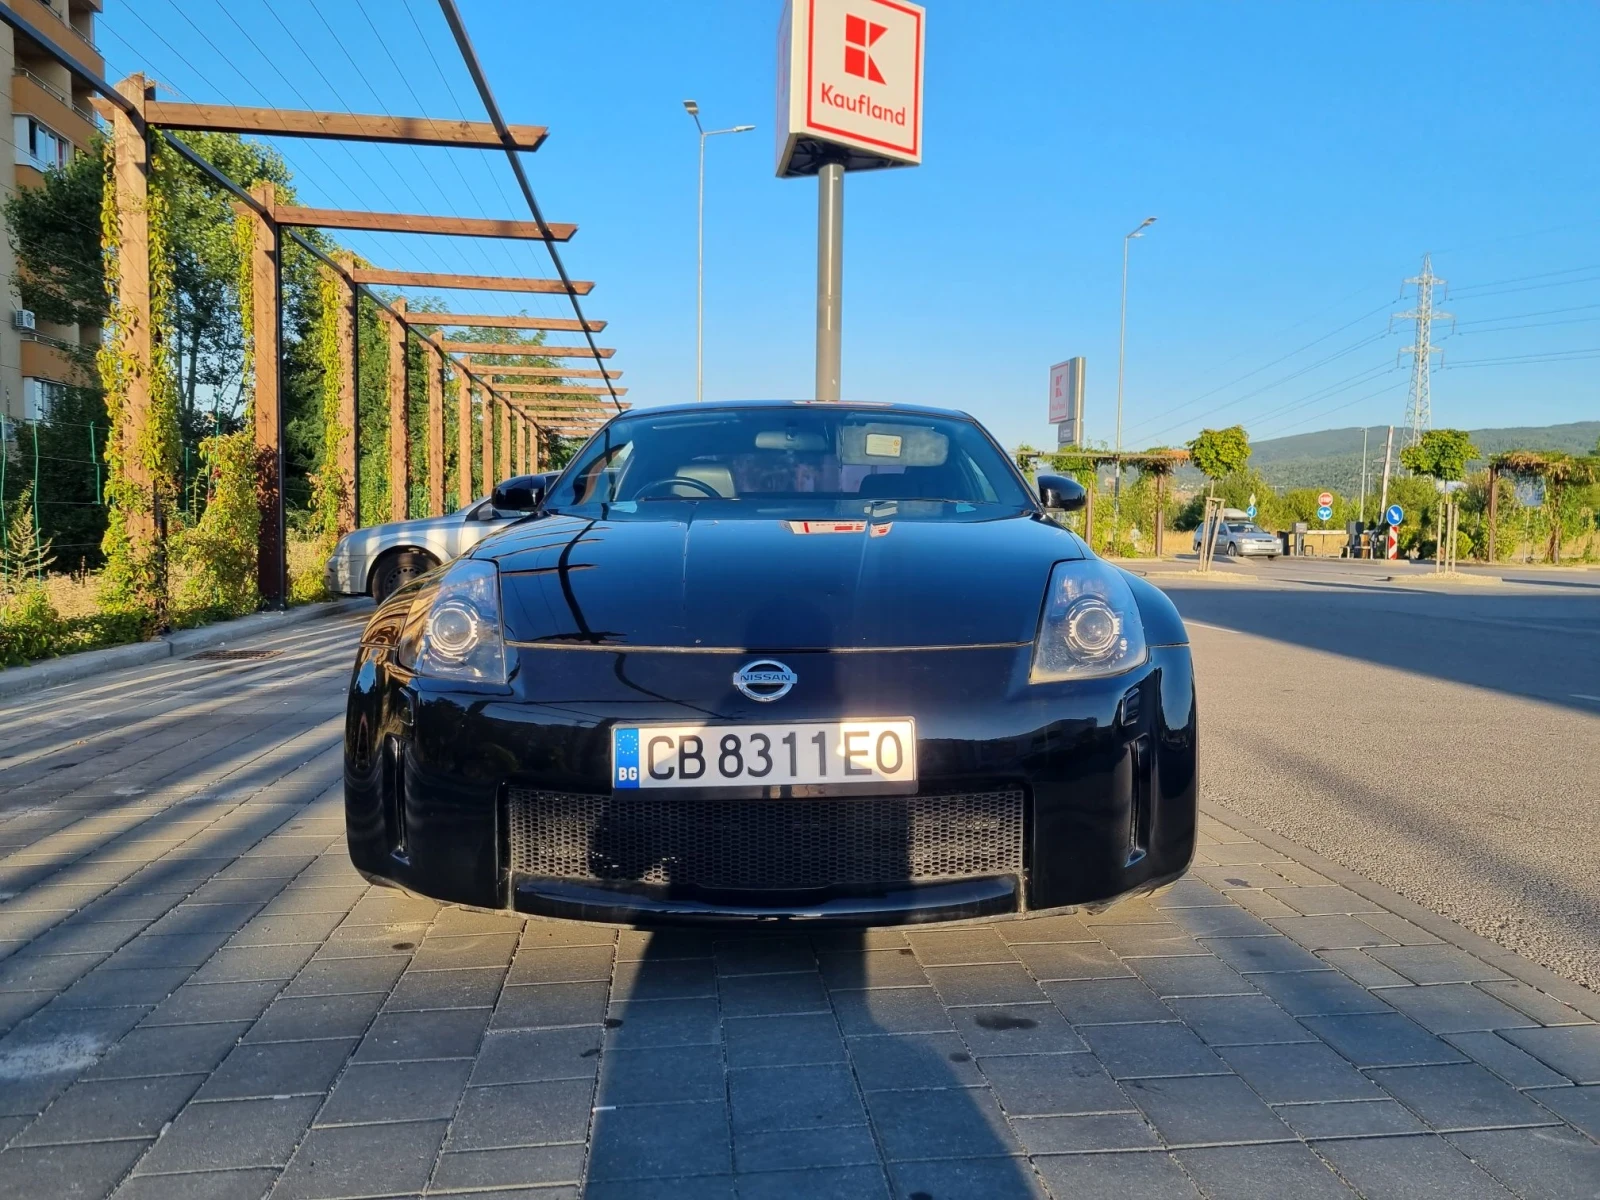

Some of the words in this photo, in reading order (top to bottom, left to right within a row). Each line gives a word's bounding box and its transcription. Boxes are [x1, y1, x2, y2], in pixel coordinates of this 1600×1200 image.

[821, 82, 906, 127] Kaufland
[740, 673, 791, 681] NISSAN
[648, 735, 706, 780] CB
[718, 731, 827, 779] 8311
[618, 766, 638, 781] BG
